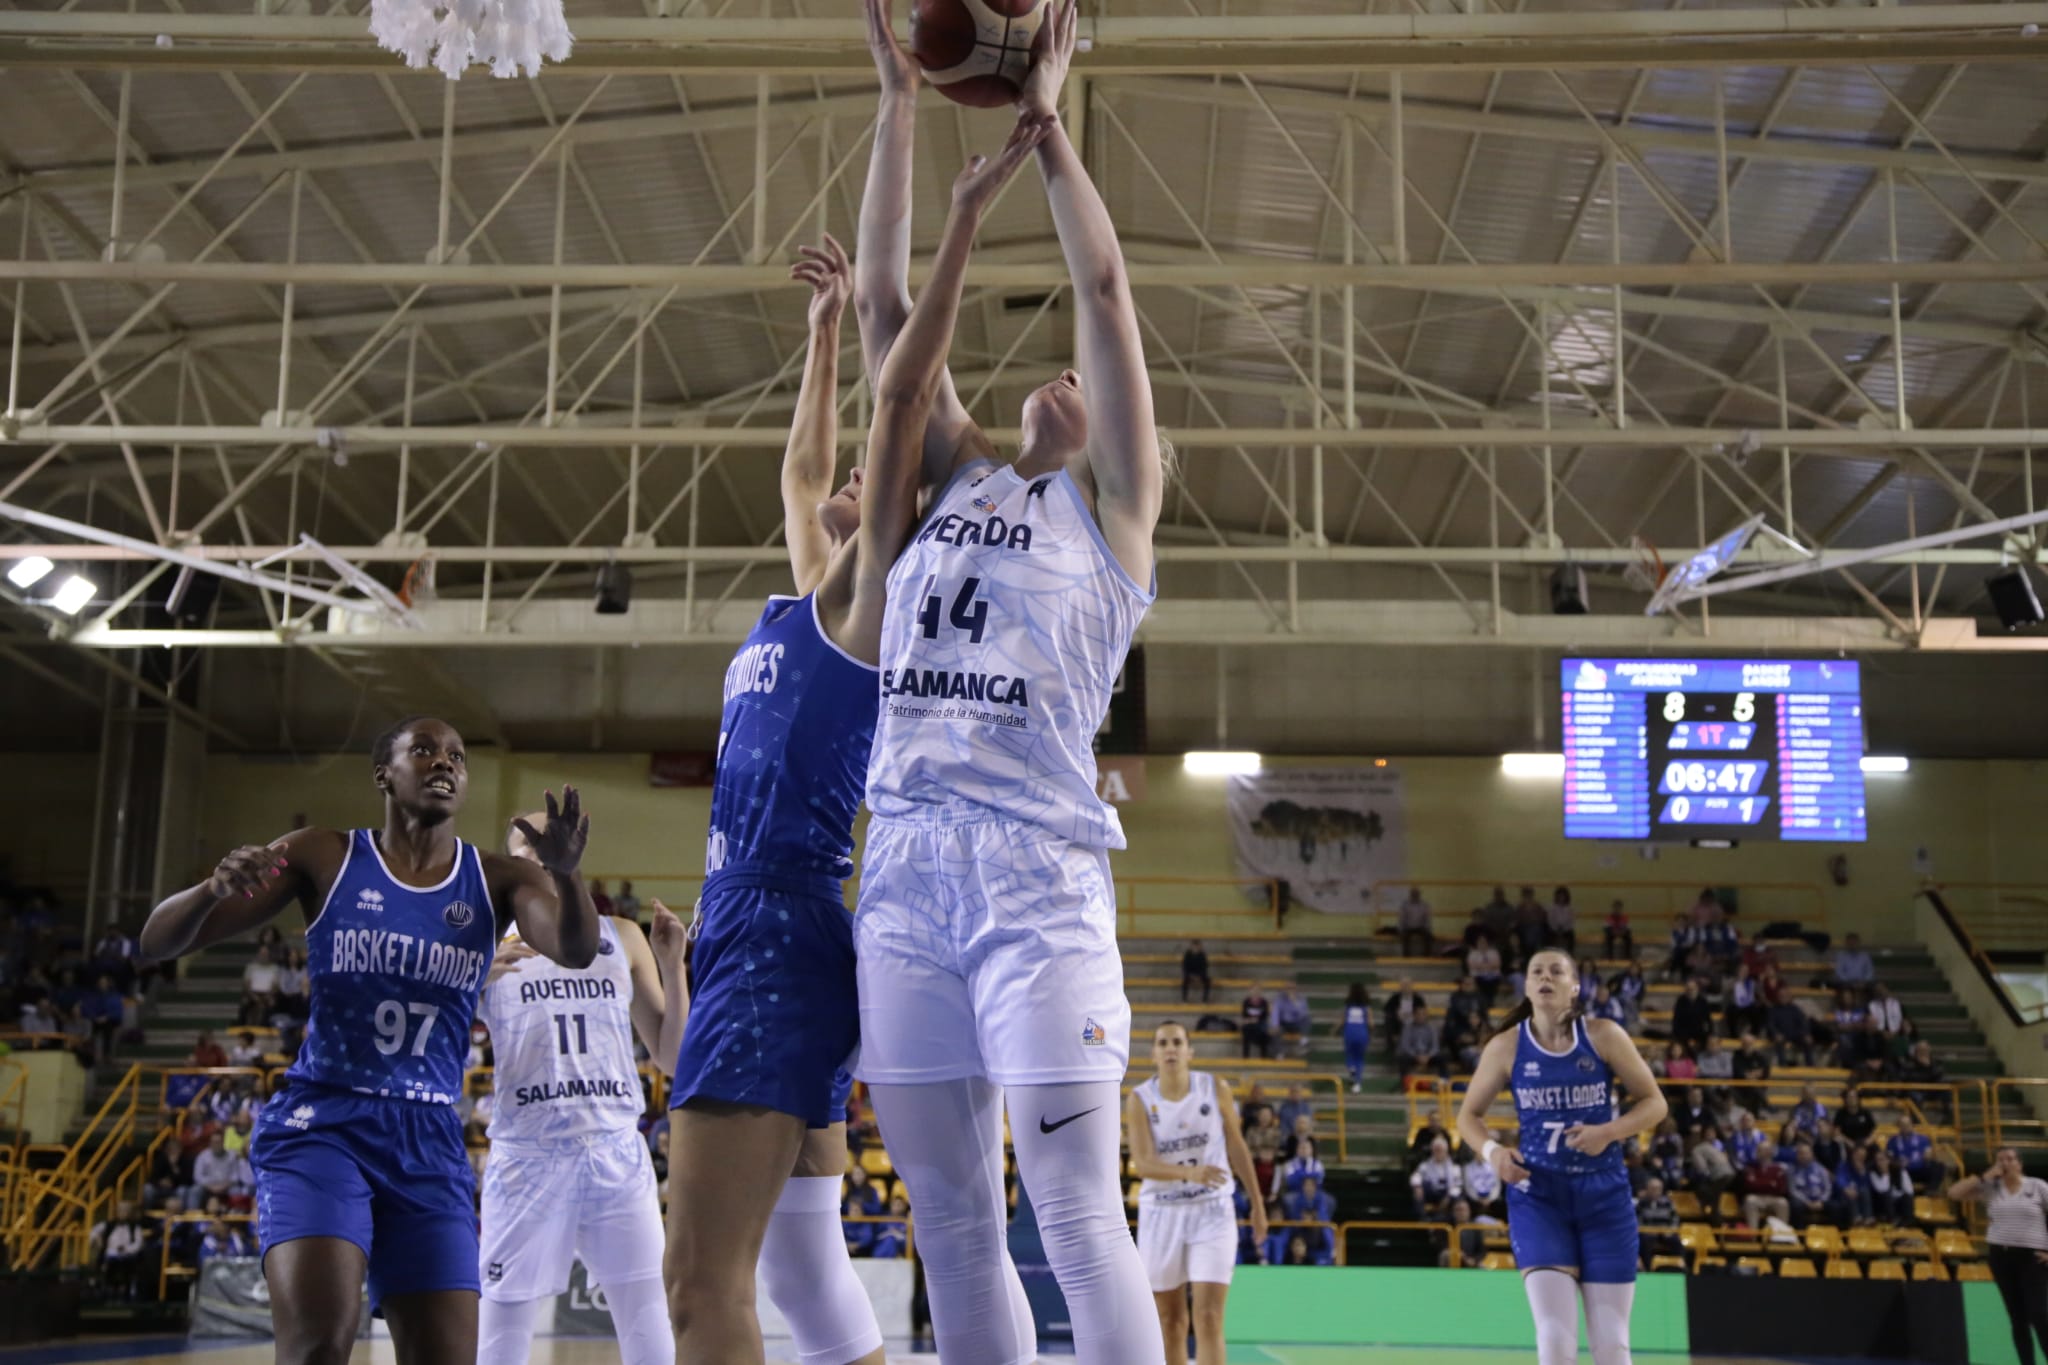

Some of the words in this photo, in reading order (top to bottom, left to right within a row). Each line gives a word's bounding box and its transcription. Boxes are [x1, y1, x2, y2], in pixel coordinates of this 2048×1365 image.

[916, 574, 988, 644] 44
[889, 703, 942, 718] Patrimonio
[944, 707, 955, 717] de
[957, 707, 966, 718] la
[969, 709, 1027, 726] Humanidad
[1664, 692, 1685, 722] 8
[1733, 692, 1755, 722] 5
[1666, 763, 1757, 792] 06:47
[1671, 796, 1690, 822] 0
[1739, 797, 1754, 822] 1
[356, 901, 384, 912] errea
[332, 929, 413, 976] BASKET
[414, 939, 484, 992] LANDES
[520, 978, 616, 1004] AVENIDA
[373, 1000, 439, 1057] 97
[554, 1014, 587, 1055] 11
